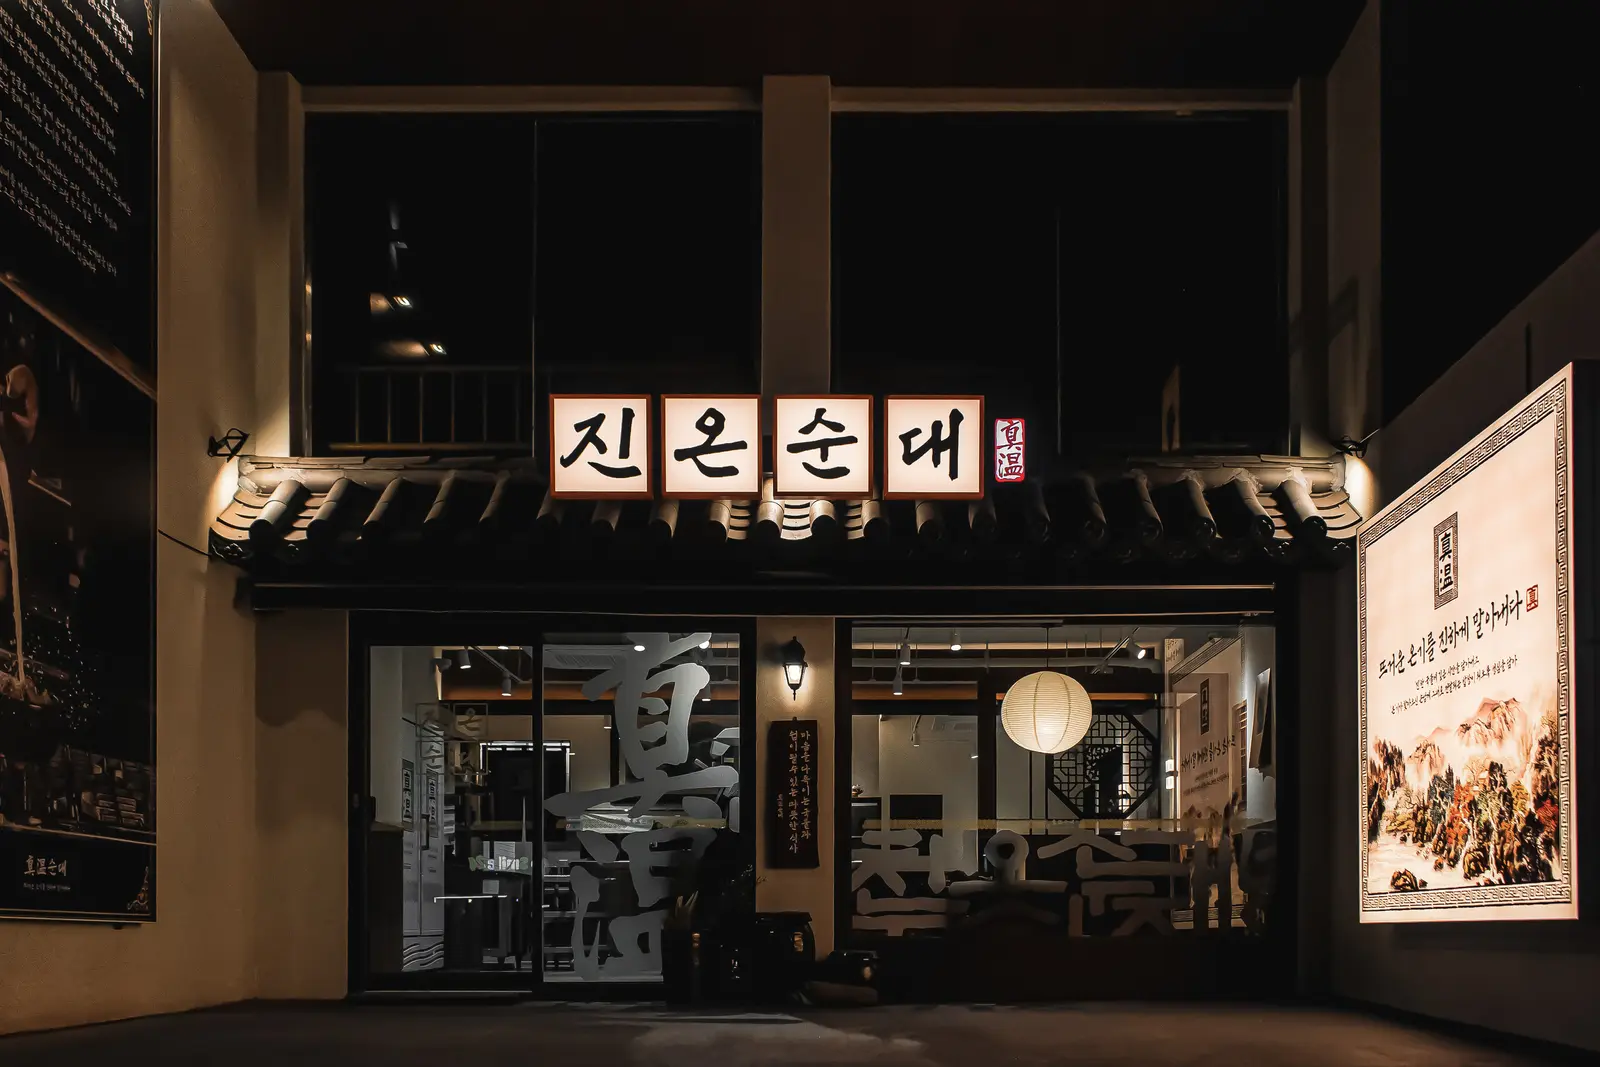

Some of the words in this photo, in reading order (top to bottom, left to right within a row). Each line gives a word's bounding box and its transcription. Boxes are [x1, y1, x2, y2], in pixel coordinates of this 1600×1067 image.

[560, 407, 964, 480] 진온순대
[1379, 649, 1405, 679] 뜨거운
[1408, 631, 1436, 666] 온기를
[1439, 616, 1469, 653] 진하게
